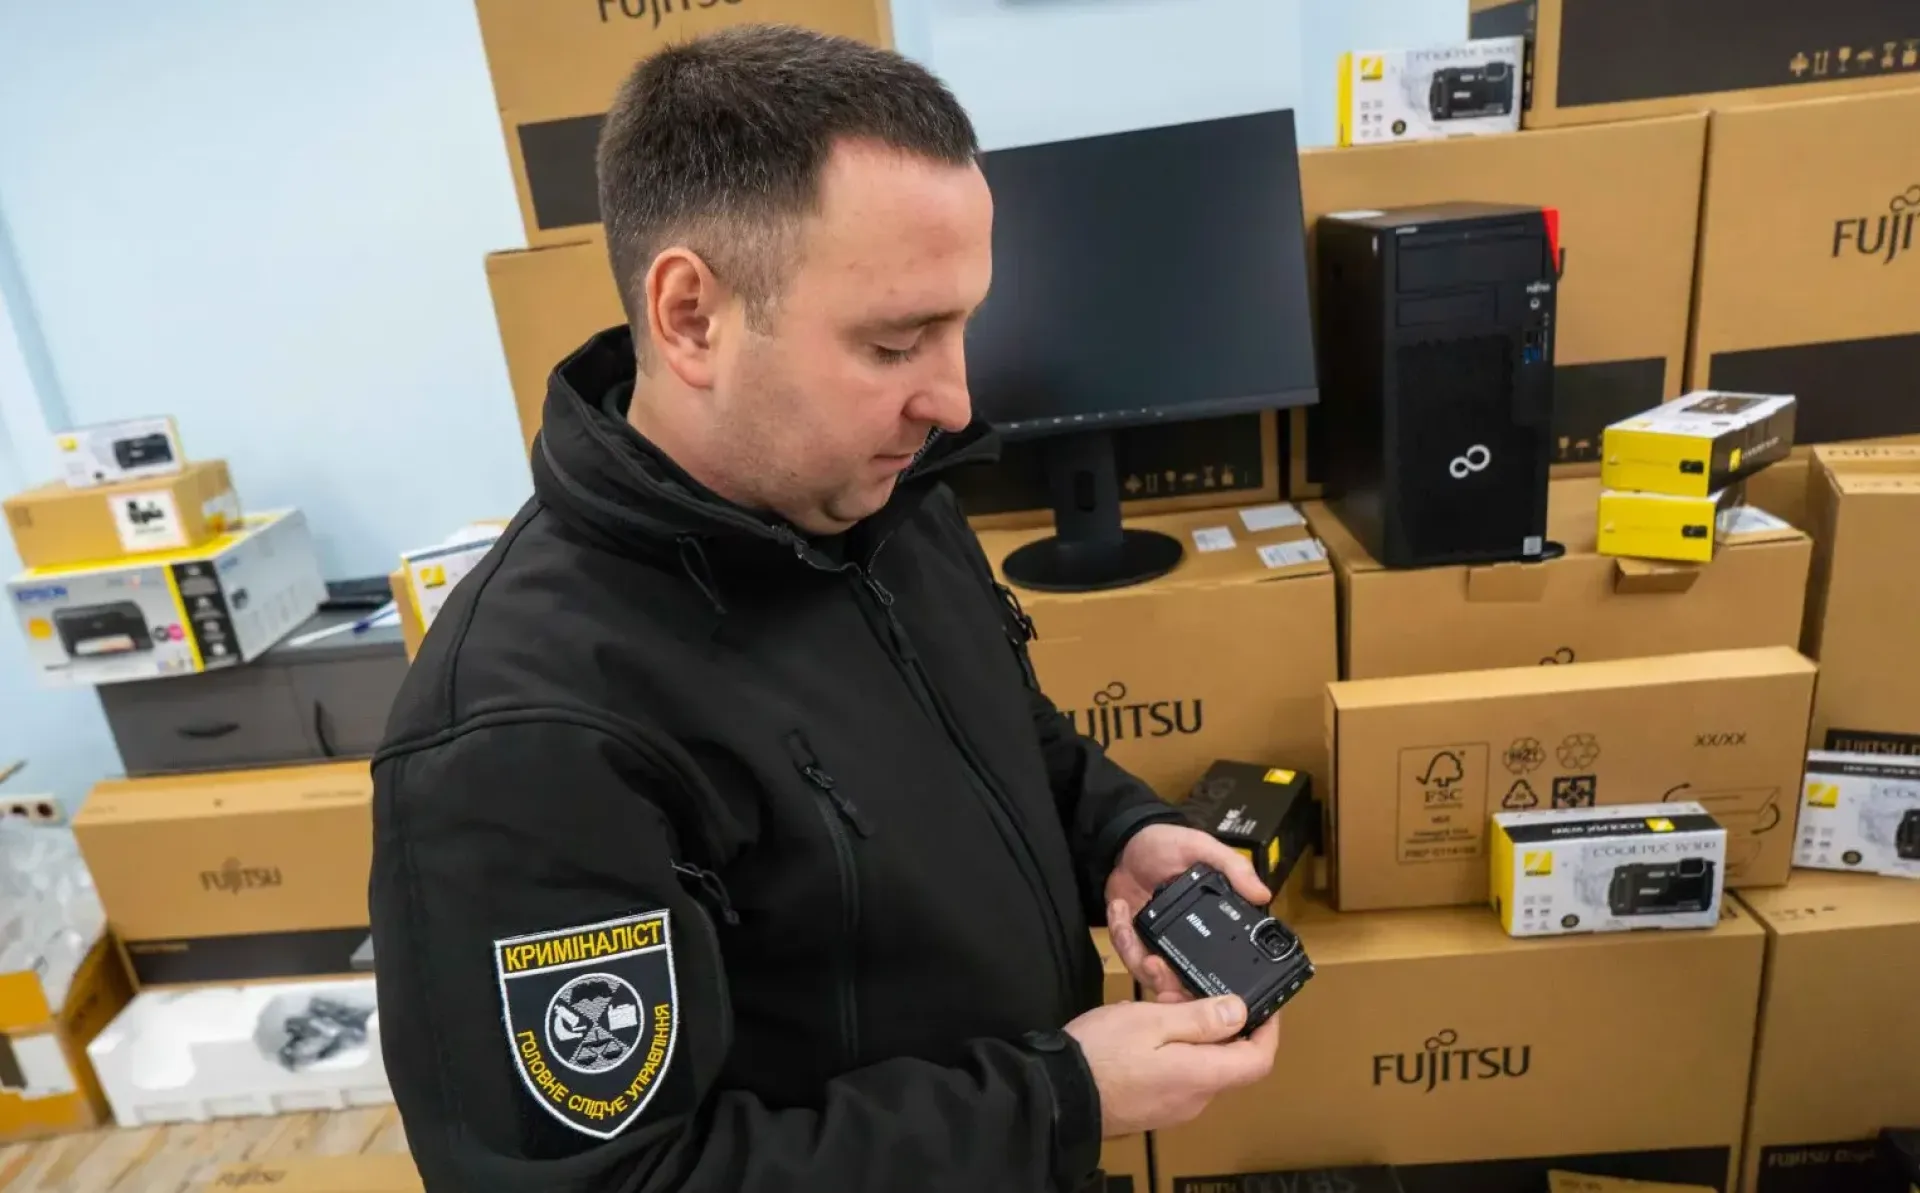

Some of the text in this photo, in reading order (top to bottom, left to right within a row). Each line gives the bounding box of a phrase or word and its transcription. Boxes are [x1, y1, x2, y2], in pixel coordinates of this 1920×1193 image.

[1832, 212, 1920, 266] FUJI
[1060, 699, 1202, 752] UJITSU
[505, 920, 662, 971] КРИМІНАЛІСТ
[1186, 913, 1211, 938] Nikon
[1208, 972, 1233, 995] COOLP
[516, 1003, 670, 1120] ГОЛОВНЕ СЛІДЧЕ УПРАВЛІННЯ
[1372, 1045, 1532, 1093] FUJITSU
